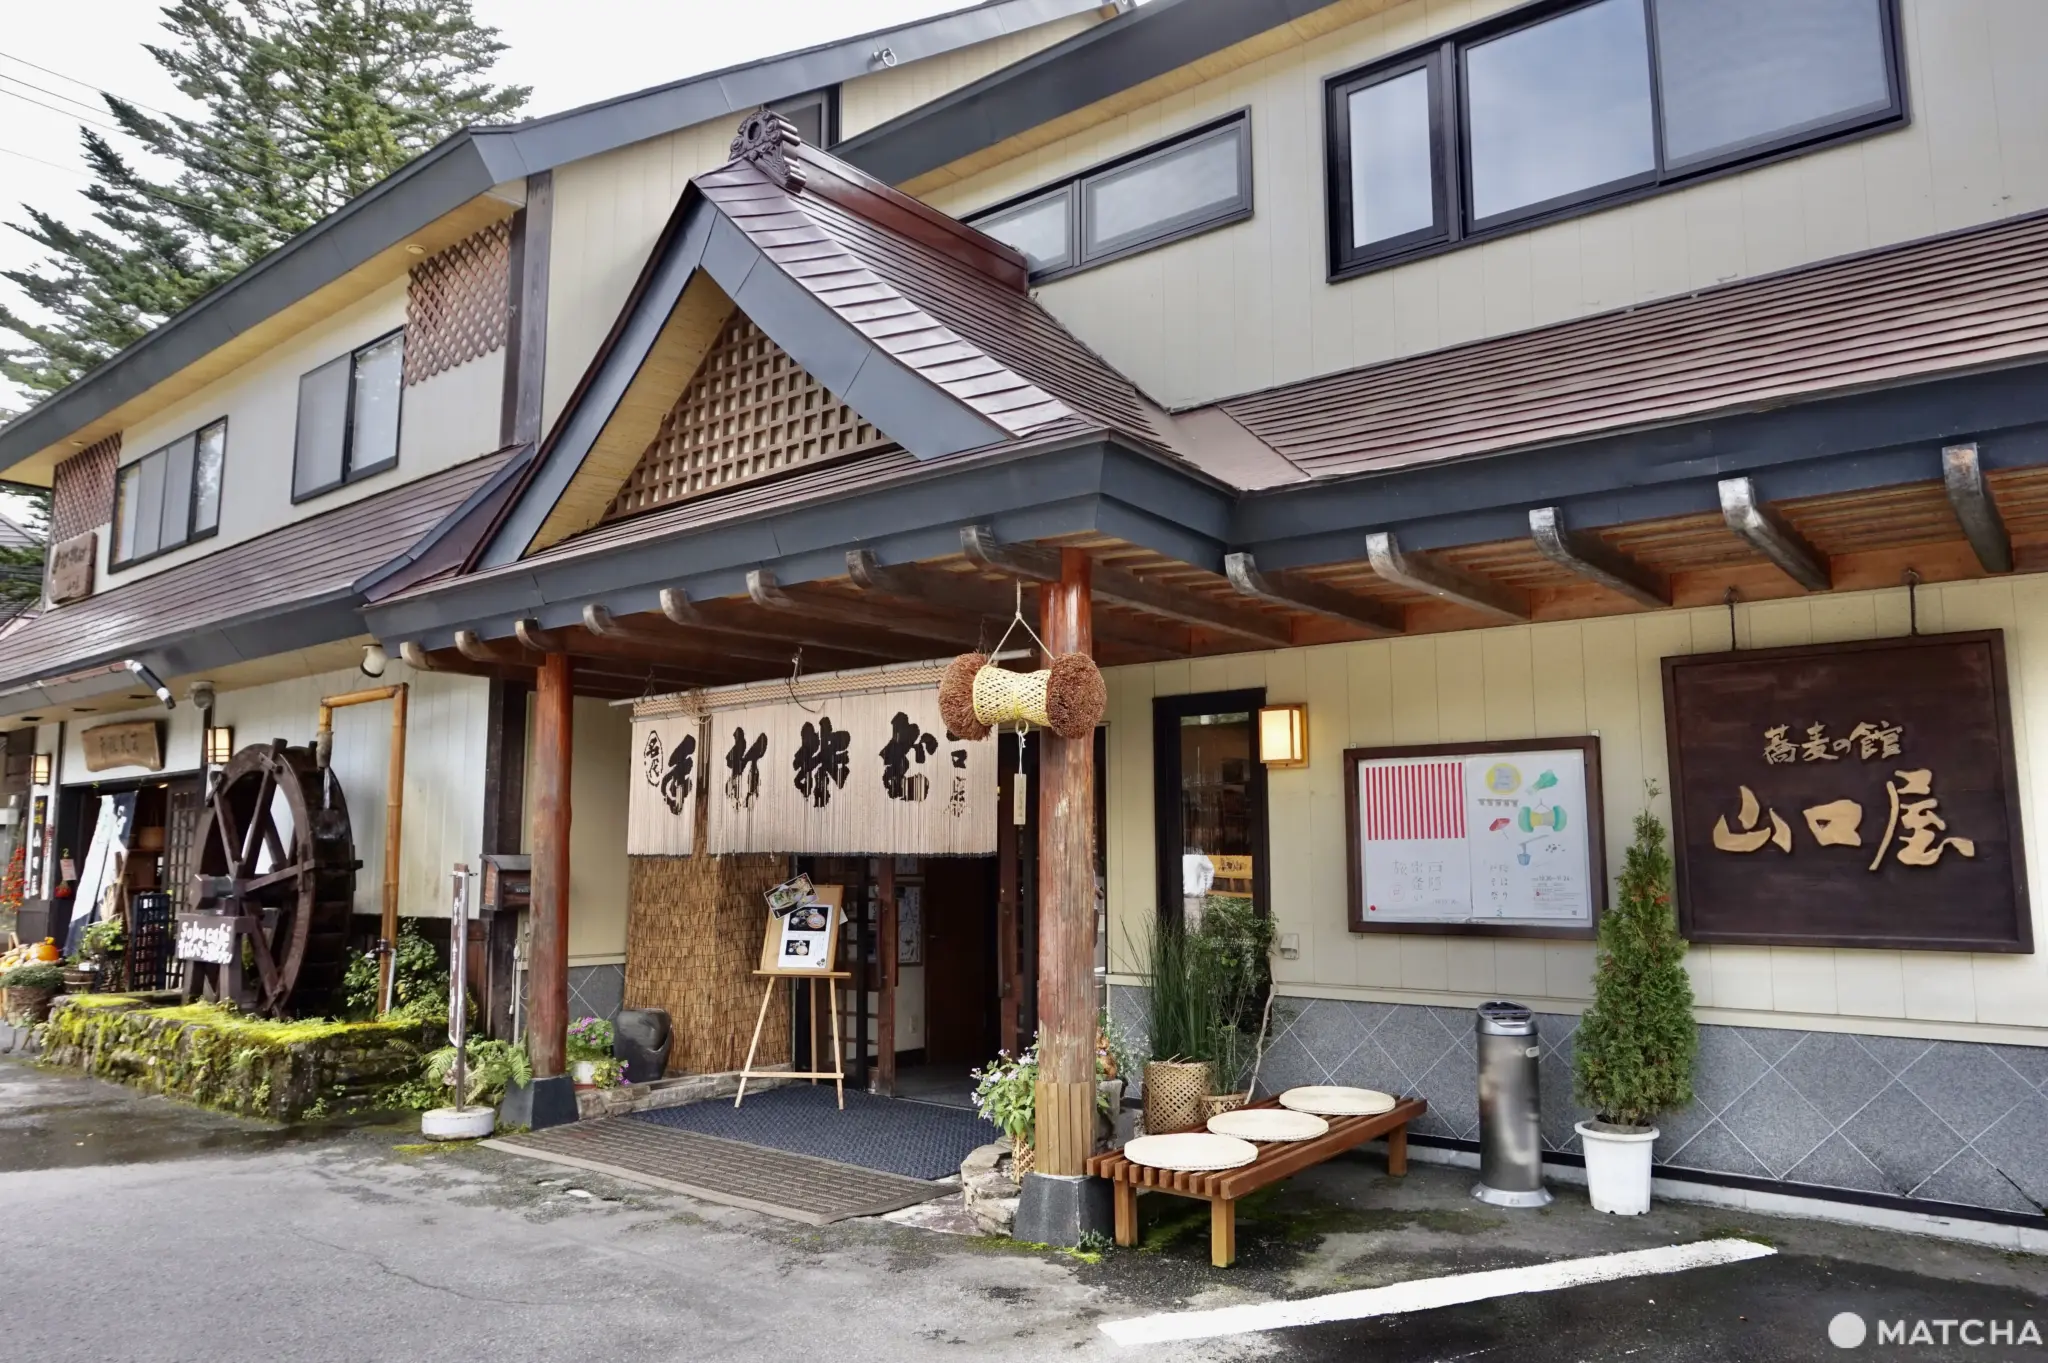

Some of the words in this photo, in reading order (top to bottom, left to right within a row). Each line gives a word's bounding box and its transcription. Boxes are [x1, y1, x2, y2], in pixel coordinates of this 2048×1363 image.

[1762, 721, 1904, 766] 蕎麦の館
[1712, 768, 1976, 872] 山口屋
